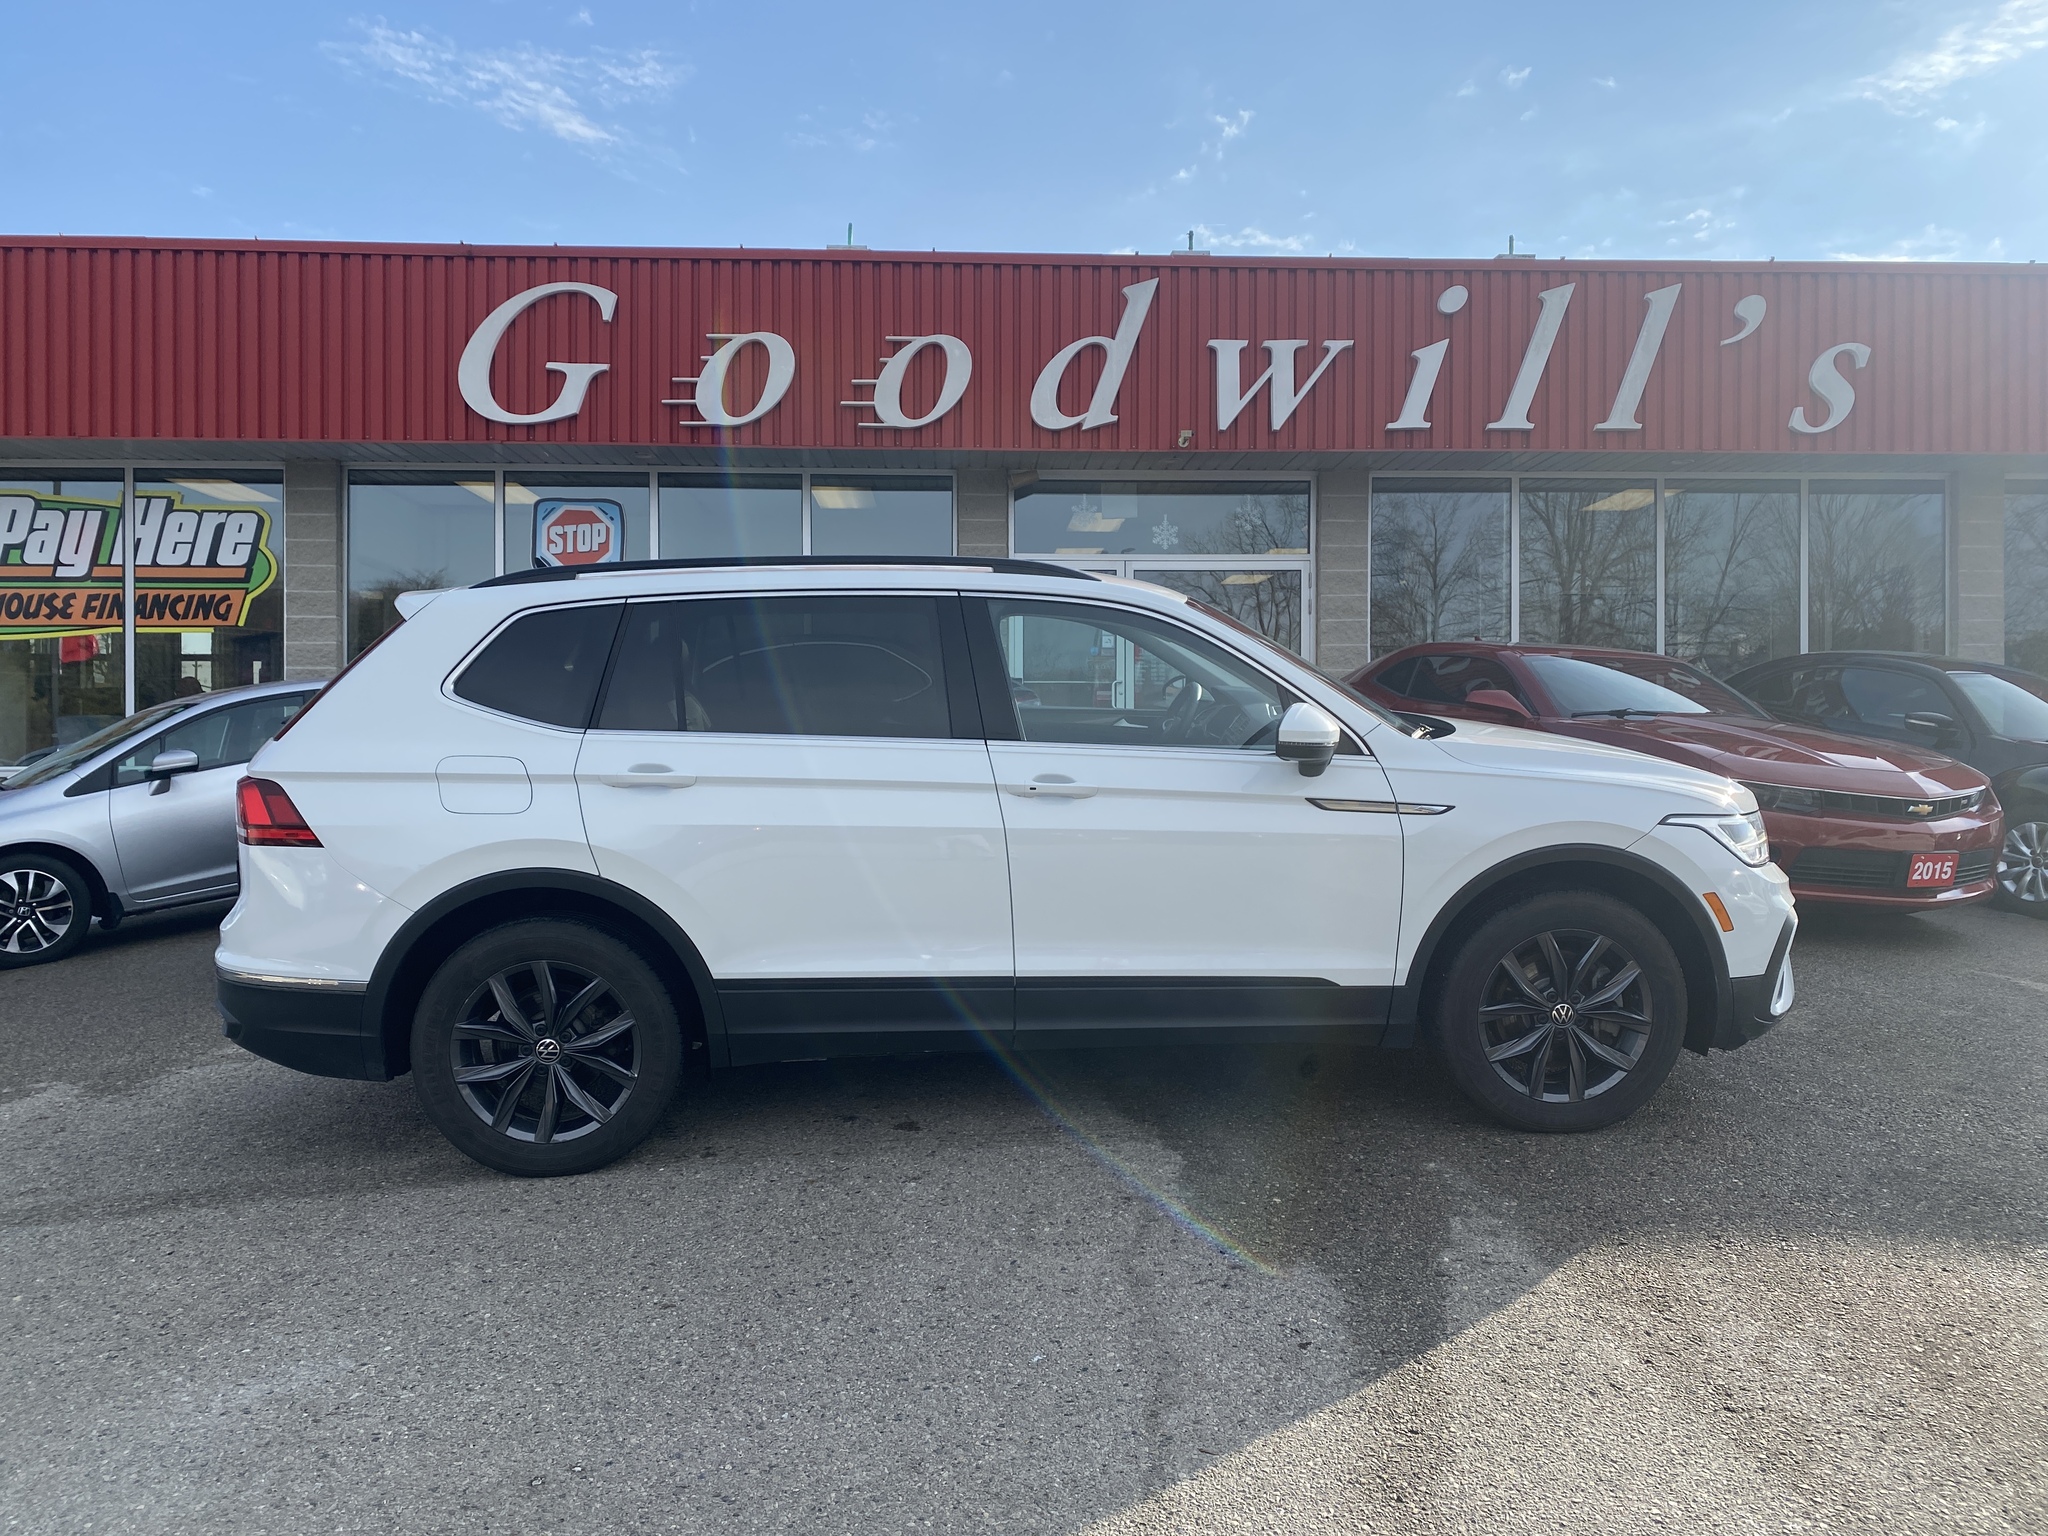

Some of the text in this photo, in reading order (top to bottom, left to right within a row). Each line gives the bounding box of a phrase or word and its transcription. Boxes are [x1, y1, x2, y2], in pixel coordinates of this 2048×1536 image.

[457, 277, 1872, 434] Goodwill's
[0, 496, 259, 578] Pay Here
[548, 522, 607, 555] STOP
[0, 592, 77, 620] OUSE
[1911, 861, 1954, 881] 2015
